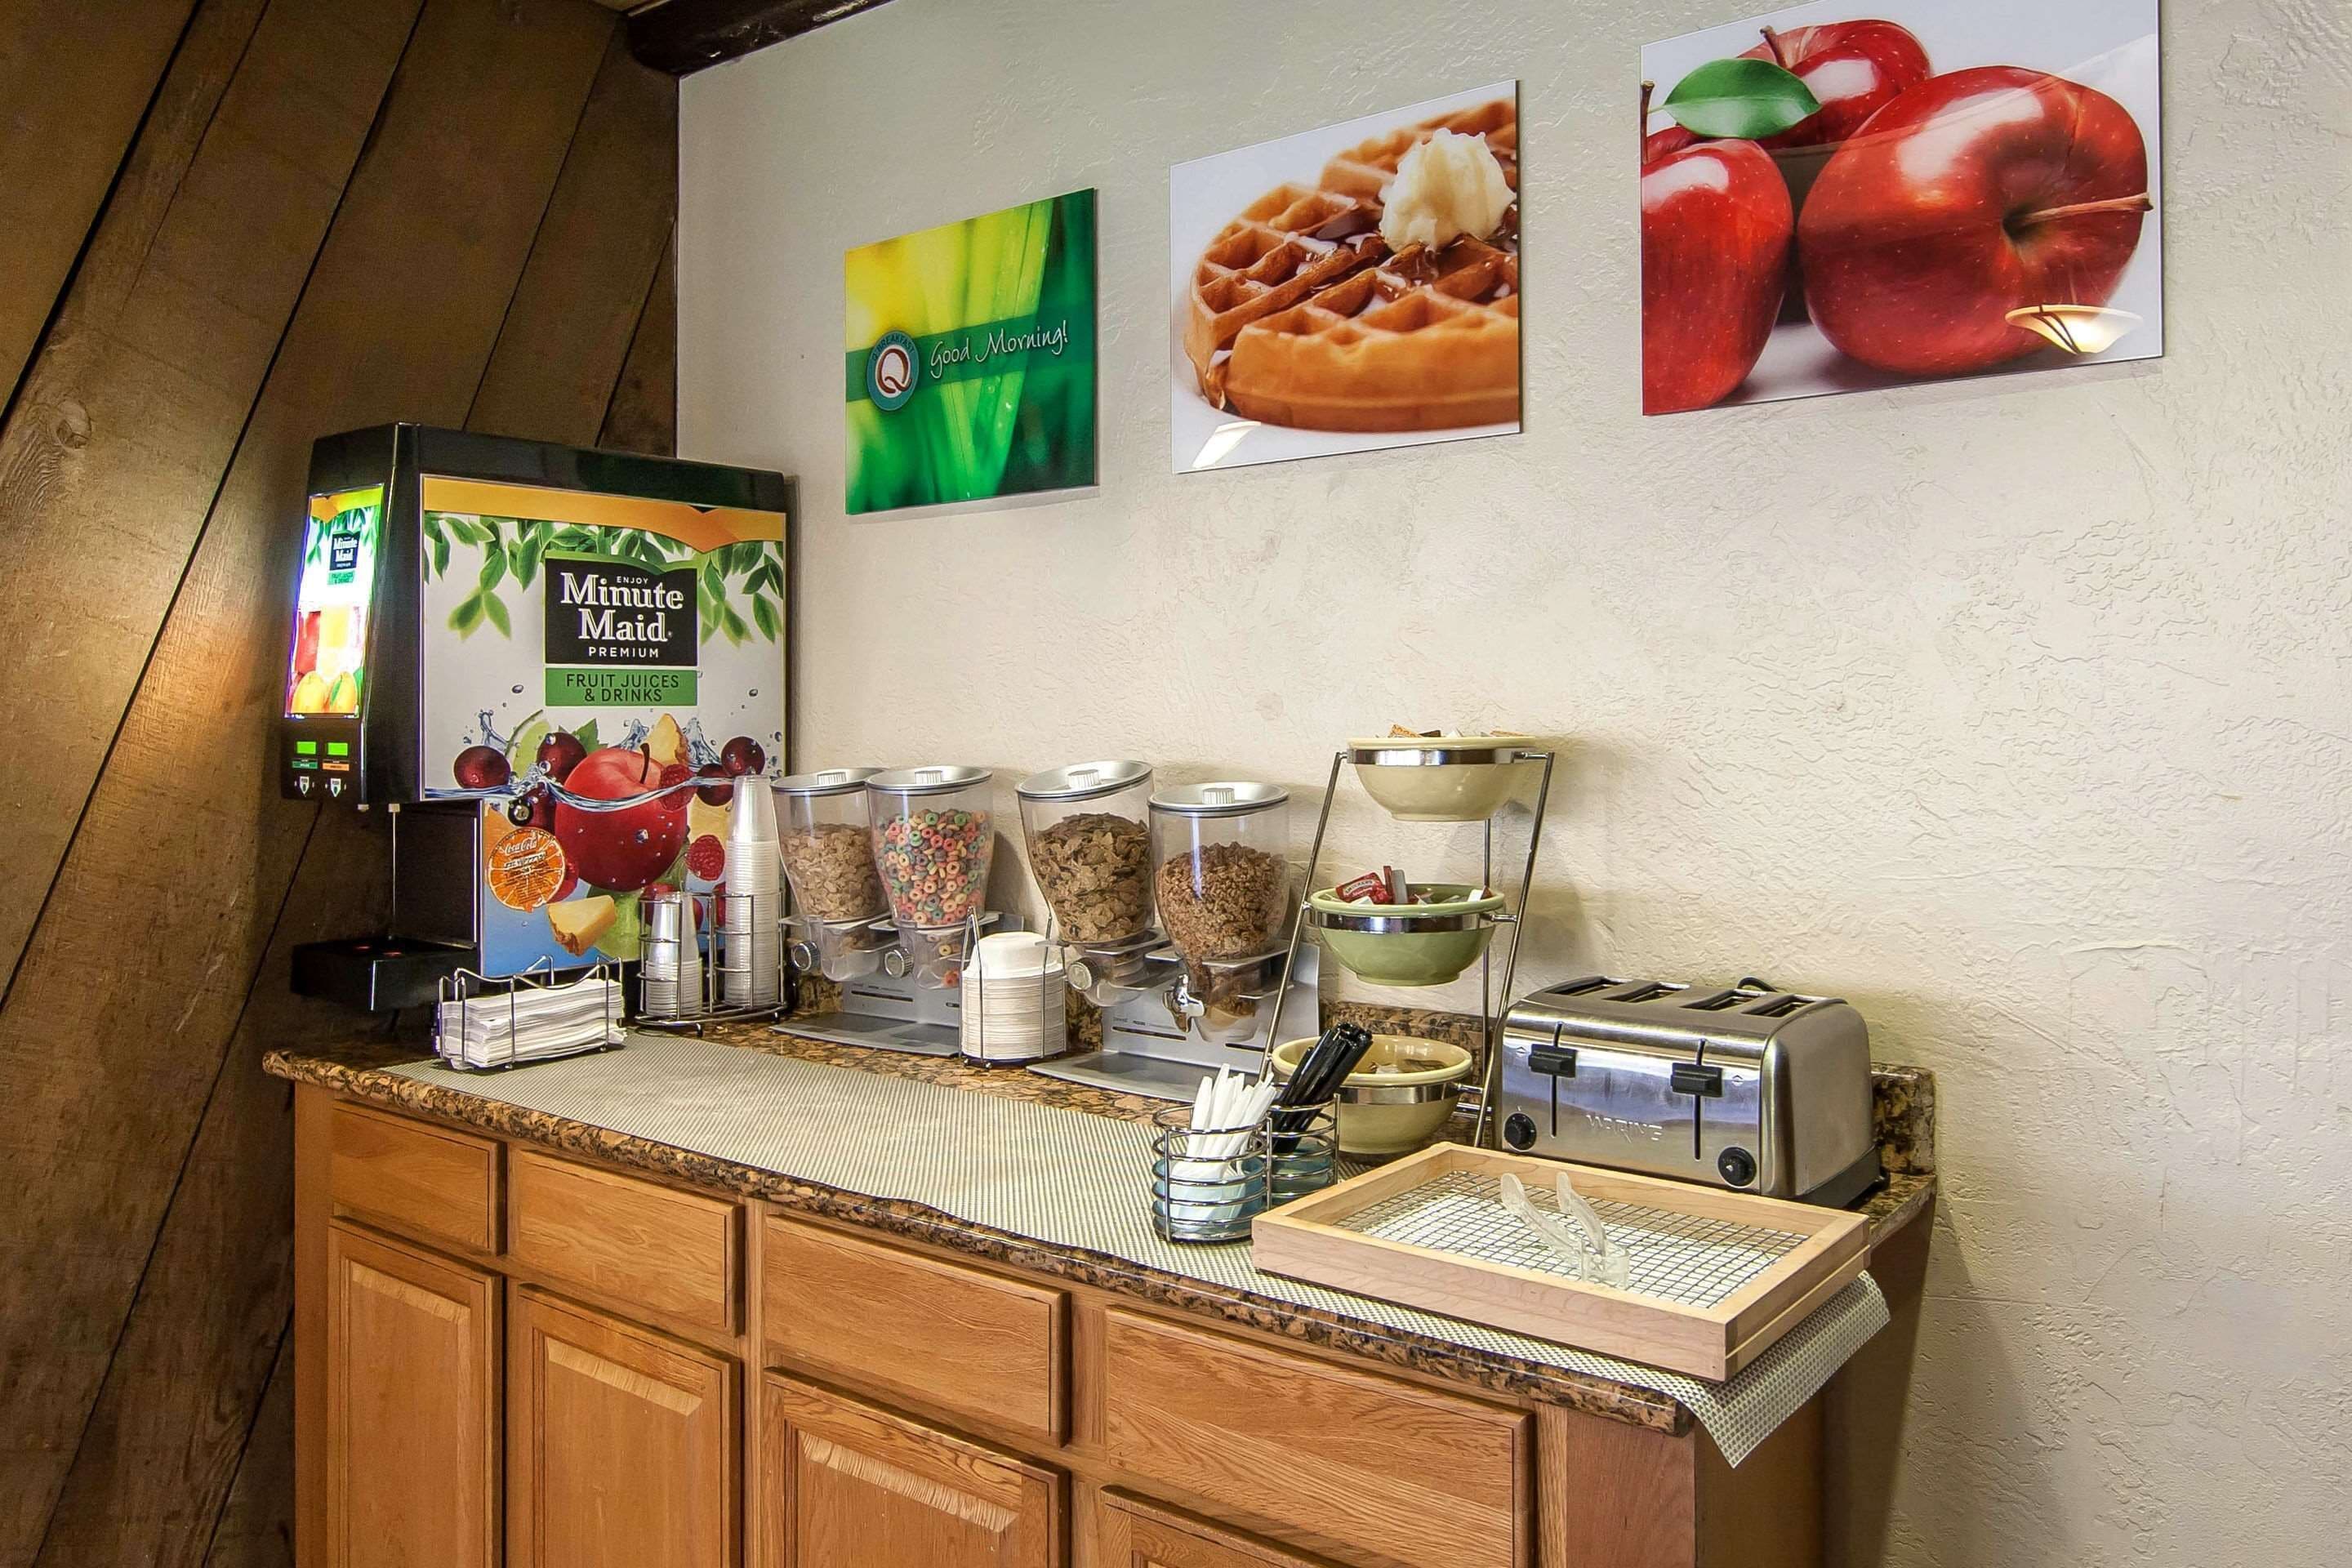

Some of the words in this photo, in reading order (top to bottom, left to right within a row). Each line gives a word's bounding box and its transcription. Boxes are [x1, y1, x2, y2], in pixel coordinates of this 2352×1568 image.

[930, 337, 970, 379] Good
[975, 319, 1068, 363] Morning!
[877, 348, 913, 394] Q
[560, 572, 684, 610] Minute
[616, 576, 649, 585] ENJOY
[578, 608, 668, 643] Maid
[588, 646, 659, 658] PREMIUM
[566, 673, 616, 688] FRUIT
[621, 675, 679, 688] JUICES
[584, 688, 595, 702] &
[601, 688, 662, 702] DRINKS
